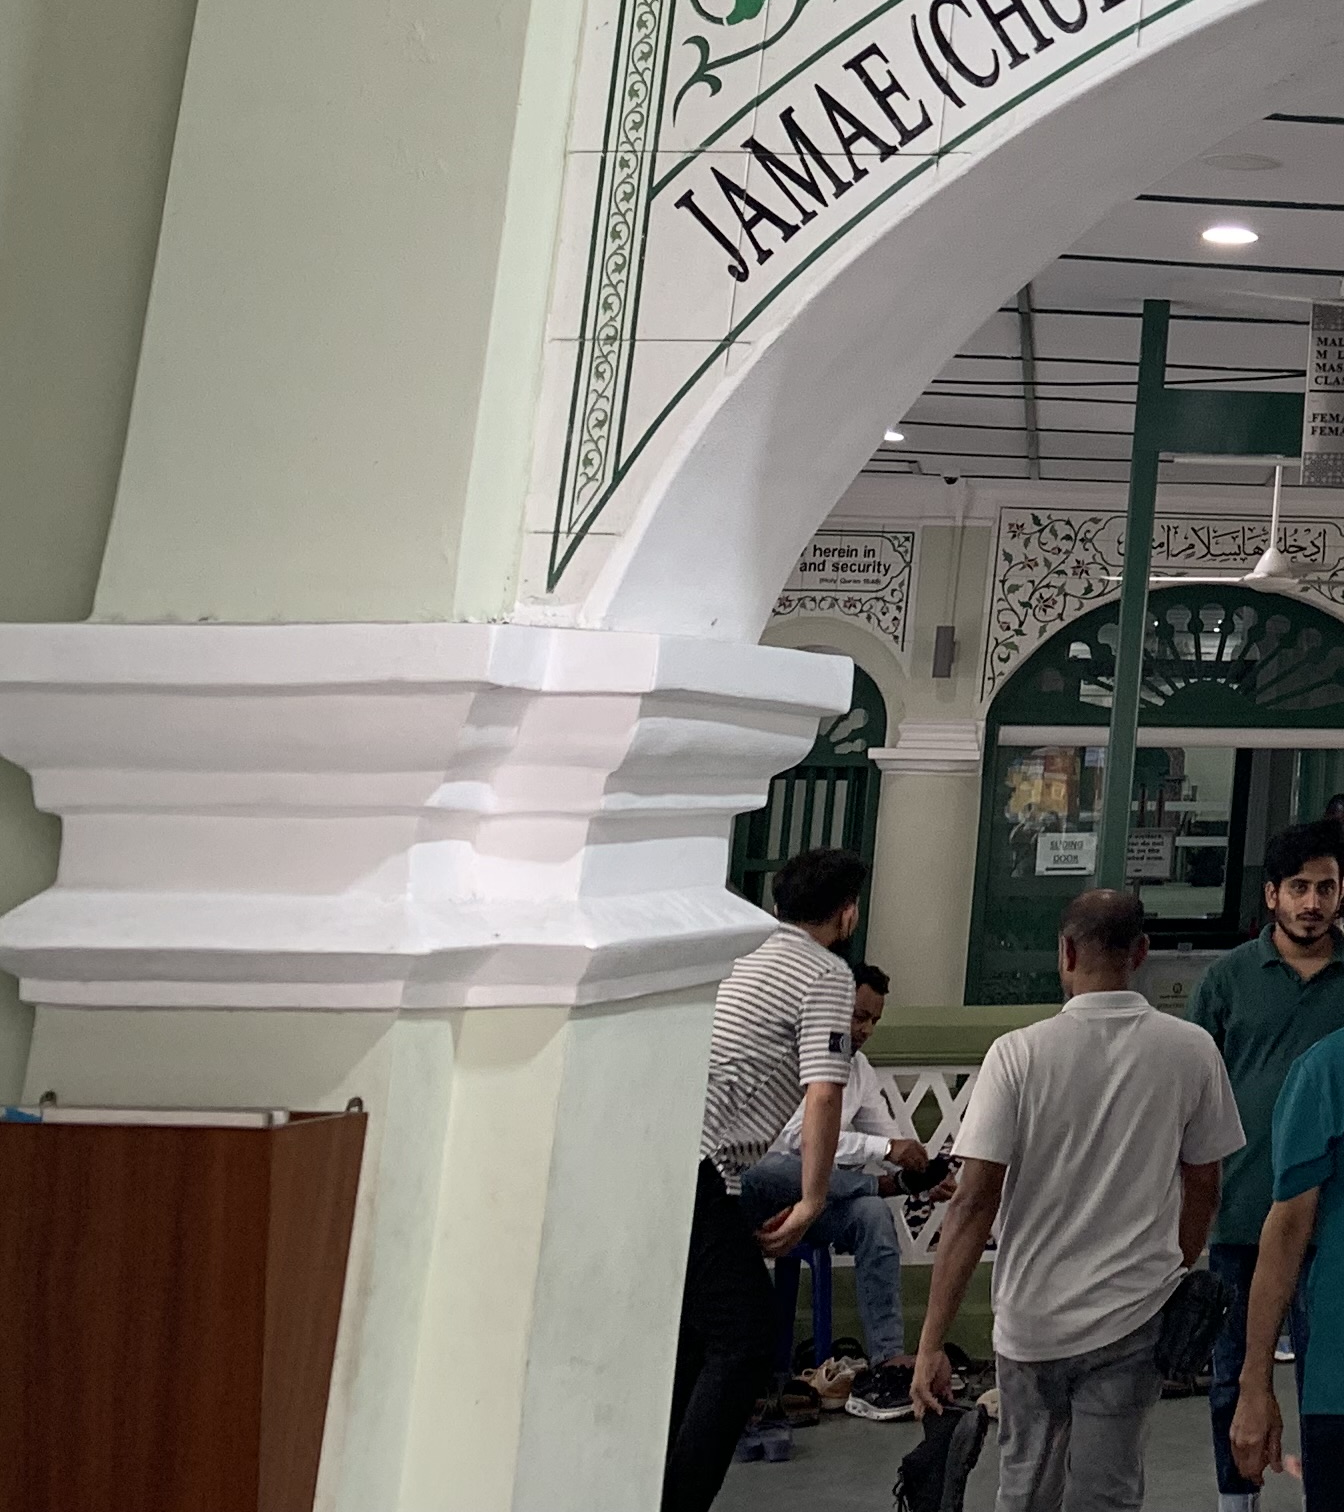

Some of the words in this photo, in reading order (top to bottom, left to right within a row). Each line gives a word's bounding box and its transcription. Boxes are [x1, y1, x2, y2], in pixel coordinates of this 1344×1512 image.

[673, 42, 934, 283] JAMAE
[812, 544, 858, 558] herein
[862, 545, 877, 559] in
[799, 559, 827, 573] and
[831, 560, 892, 577] security
